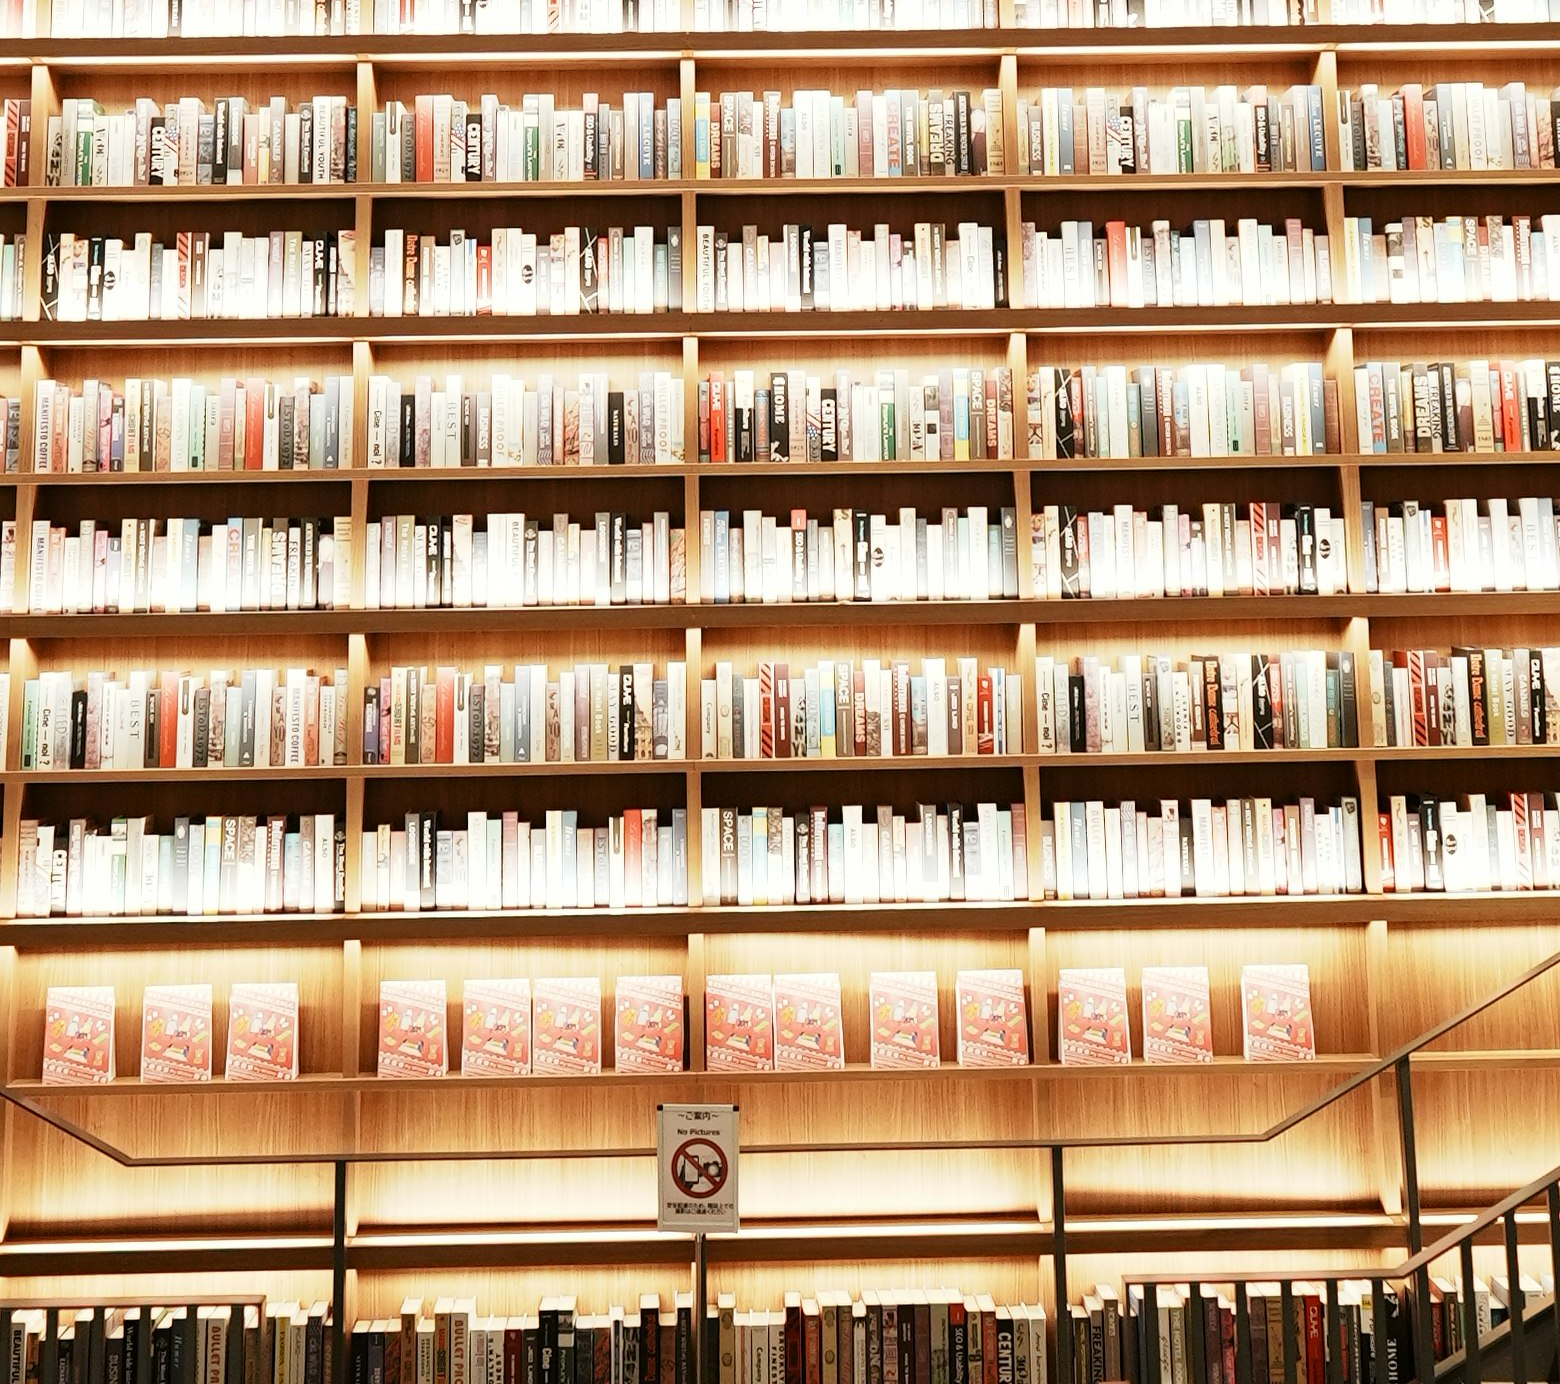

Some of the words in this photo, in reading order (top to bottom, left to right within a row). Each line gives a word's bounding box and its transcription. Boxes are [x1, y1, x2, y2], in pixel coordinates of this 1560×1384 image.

[724, 95, 734, 131] SPACE
[929, 103, 943, 163] DREAMS
[151, 126, 165, 178] CENTURY
[468, 123, 480, 174] CENTURY
[711, 122, 721, 169] DREAMS
[888, 102, 899, 168] CREATE
[945, 114, 954, 165] FREAKING
[1121, 116, 1133, 167] CENTURY
[1465, 218, 1477, 255] SPACE
[659, 381, 668, 414] BULLET
[972, 371, 982, 409] SPACE
[1369, 374, 1384, 443] CREATE
[1414, 376, 1430, 437] DREAMS
[40, 397, 49, 440] MANIFESTO
[447, 402, 456, 440] BEST
[822, 399, 835, 452] CENTURY
[986, 399, 996, 447] DREAMS
[1389, 418, 1398, 439] BOOK
[1430, 386, 1441, 439] FREAKING
[39, 442, 48, 469] COFFEE
[659, 418, 668, 453] PROOF
[838, 664, 848, 703] SPACE
[1519, 674, 1528, 718] CANNES
[130, 699, 140, 739] BEST
[291, 688, 300, 733] MANIFESTO
[855, 692, 866, 743] DREAMS
[1129, 684, 1139, 724] BEST
[1492, 698, 1500, 717] Book
[1505, 701, 1515, 738] GOOD
[291, 735, 299, 763] COFFEE
[608, 716, 618, 753] GOOD
[224, 819, 237, 860] SPACE
[723, 811, 733, 851] SPACE
[12, 1330, 21, 1384] BEAUTIFUL
[211, 1326, 222, 1365] BULLET
[454, 1321, 463, 1359] BULLET
[755, 1347, 763, 1382] Company
